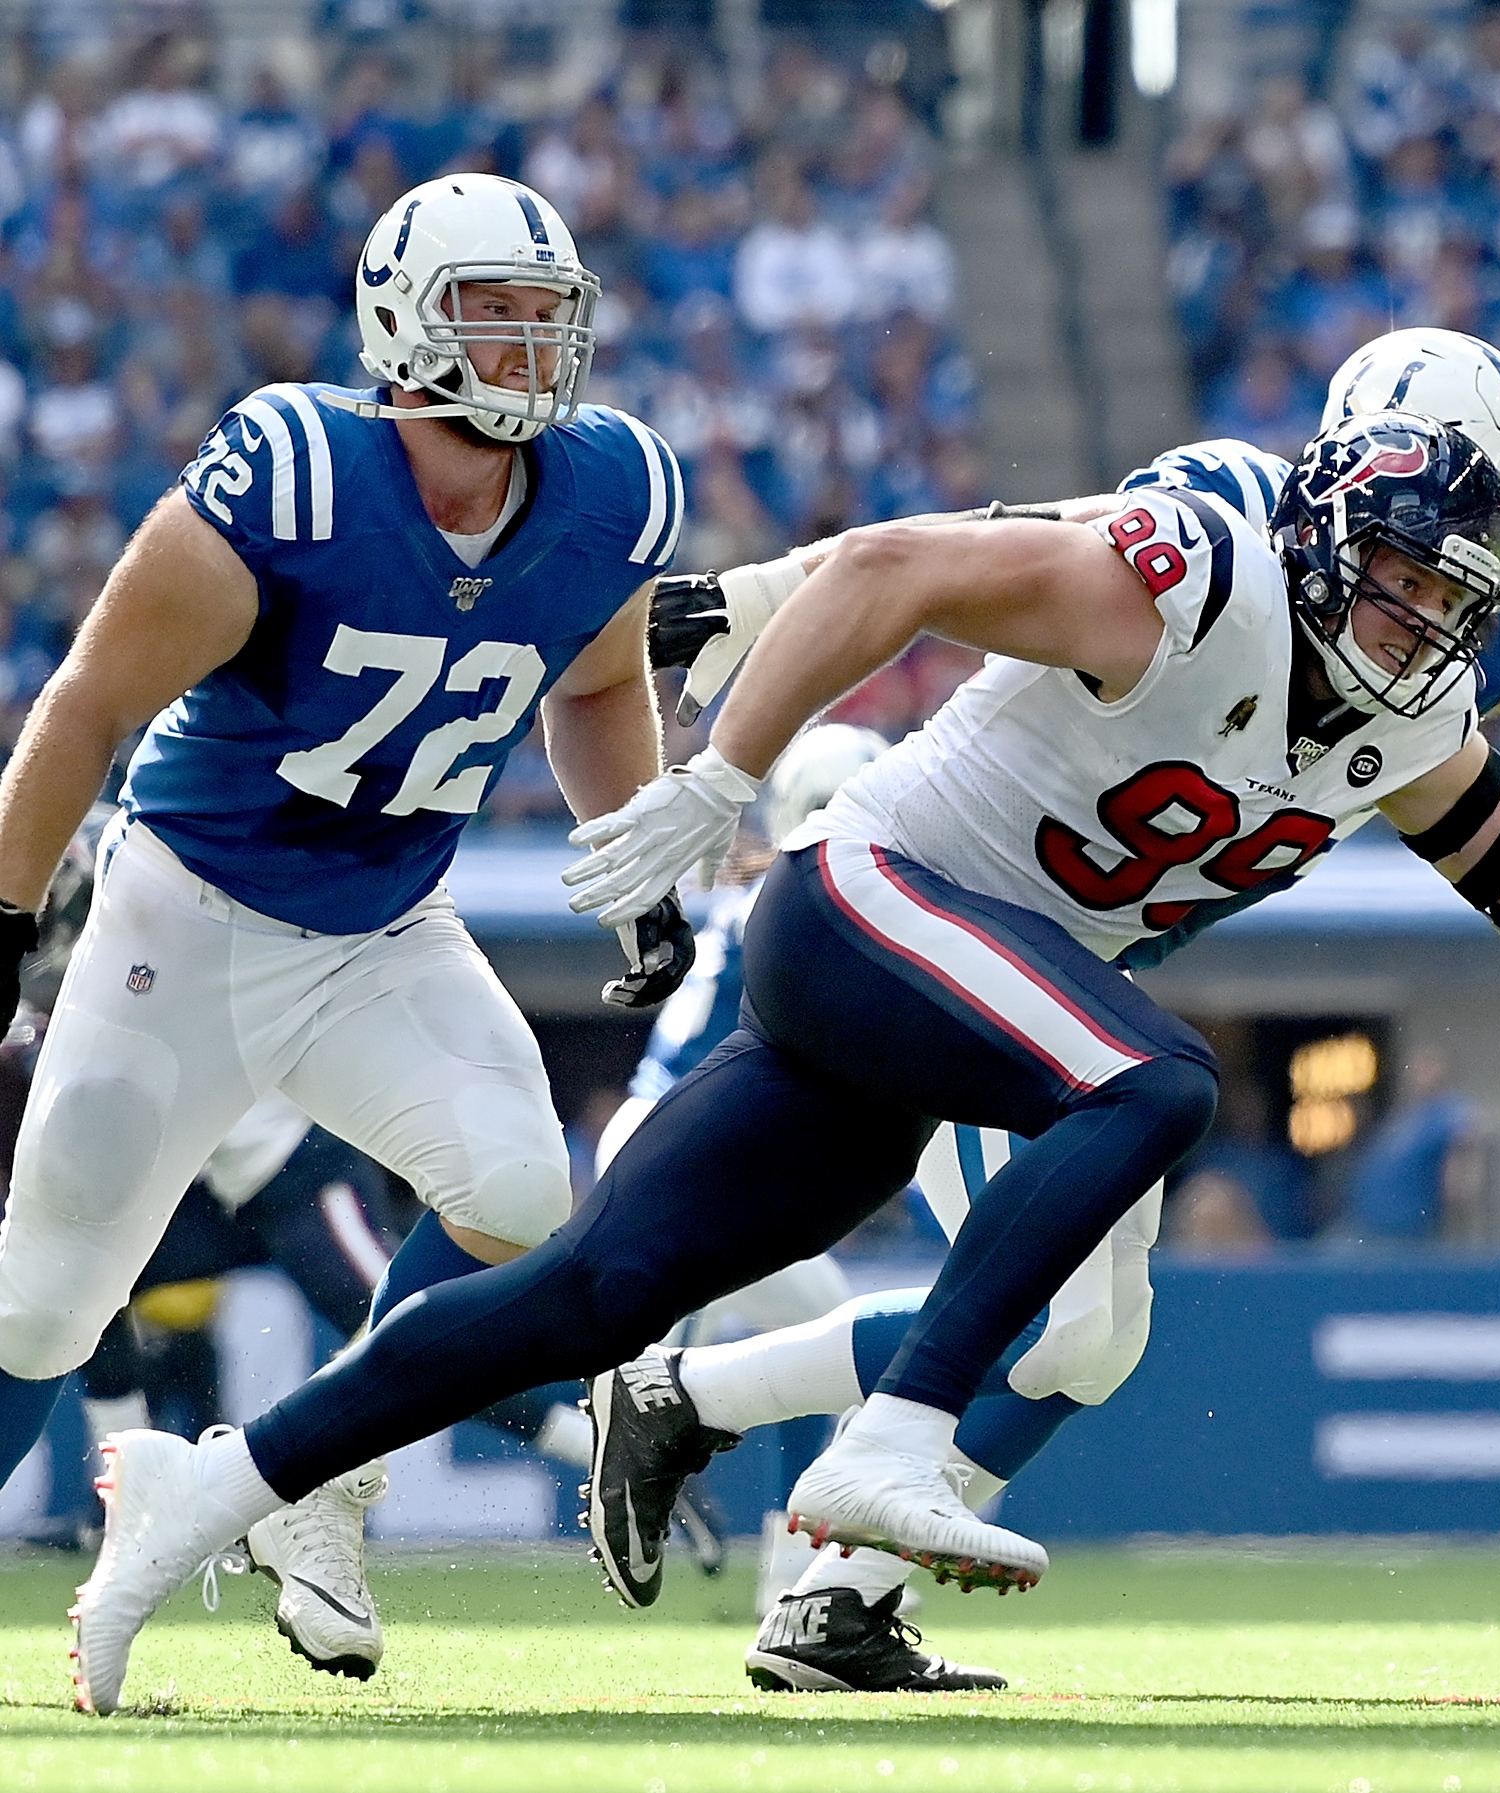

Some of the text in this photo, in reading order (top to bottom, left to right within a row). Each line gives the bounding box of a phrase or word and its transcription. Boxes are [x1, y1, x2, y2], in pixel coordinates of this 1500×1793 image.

[182, 425, 253, 526] 72
[276, 623, 547, 816] 72
[1035, 760, 1336, 931] 99
